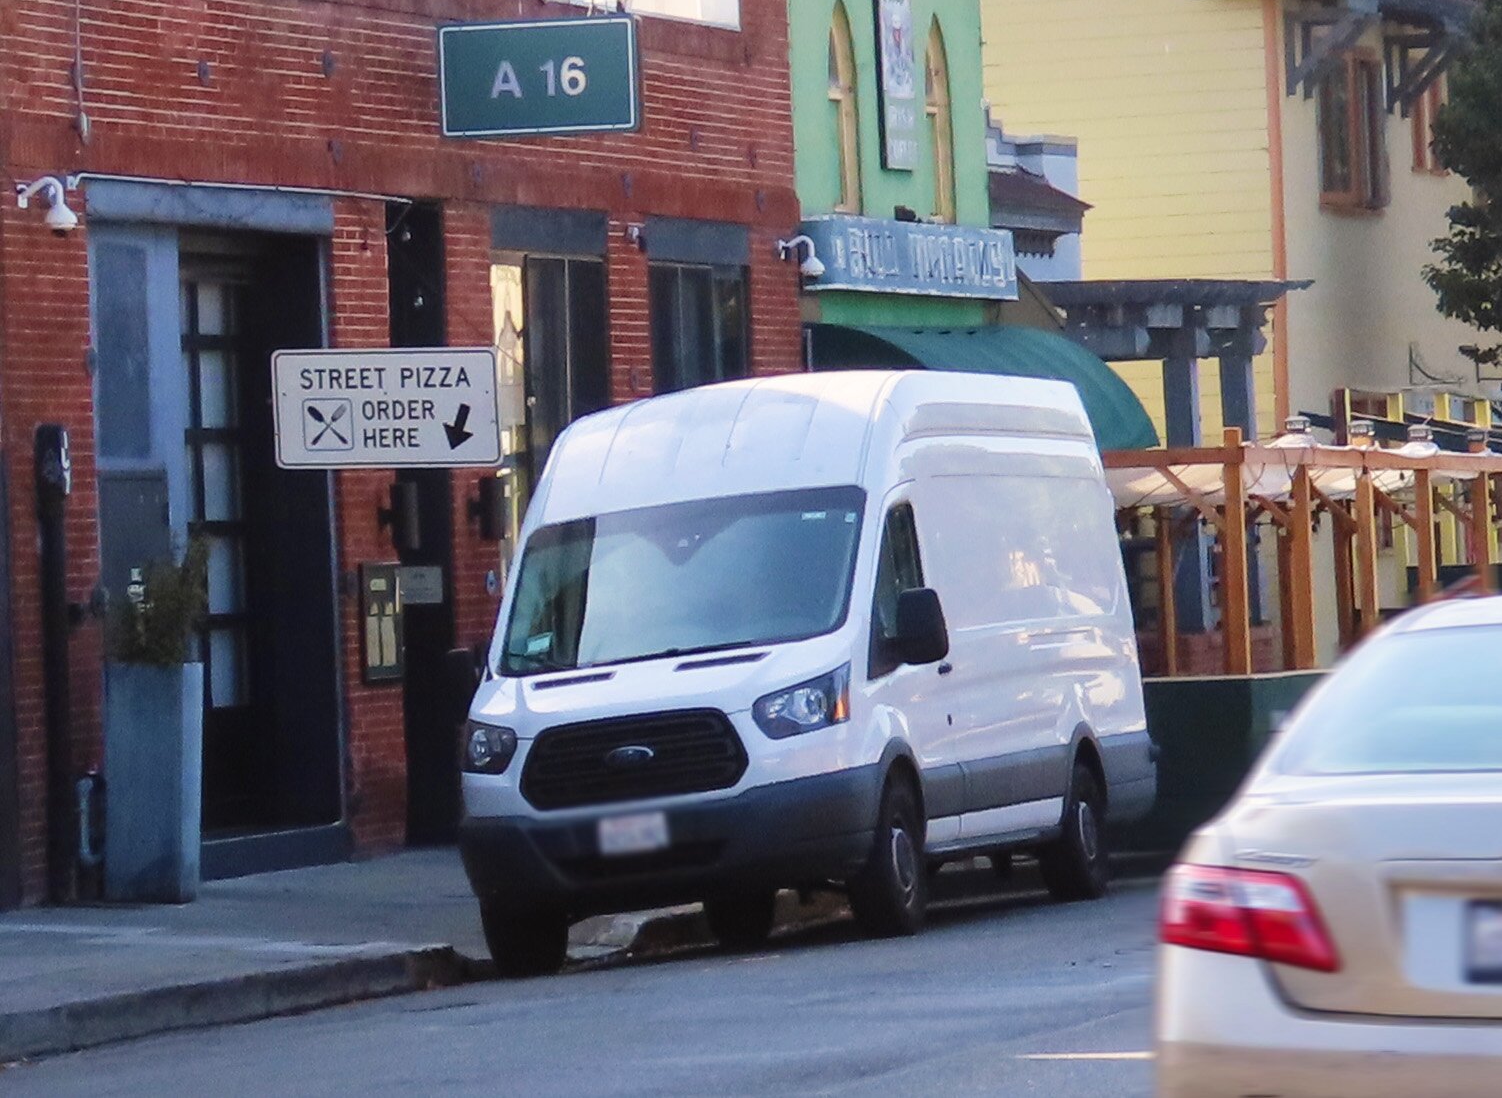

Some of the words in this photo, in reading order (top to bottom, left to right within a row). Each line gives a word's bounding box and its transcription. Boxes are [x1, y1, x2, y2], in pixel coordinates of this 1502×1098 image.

[491, 60, 522, 99] A
[539, 55, 588, 97] 16
[299, 367, 387, 390] STREET
[400, 366, 472, 389] PIZZA
[362, 399, 436, 421] ORDER
[363, 427, 421, 448] HERE
